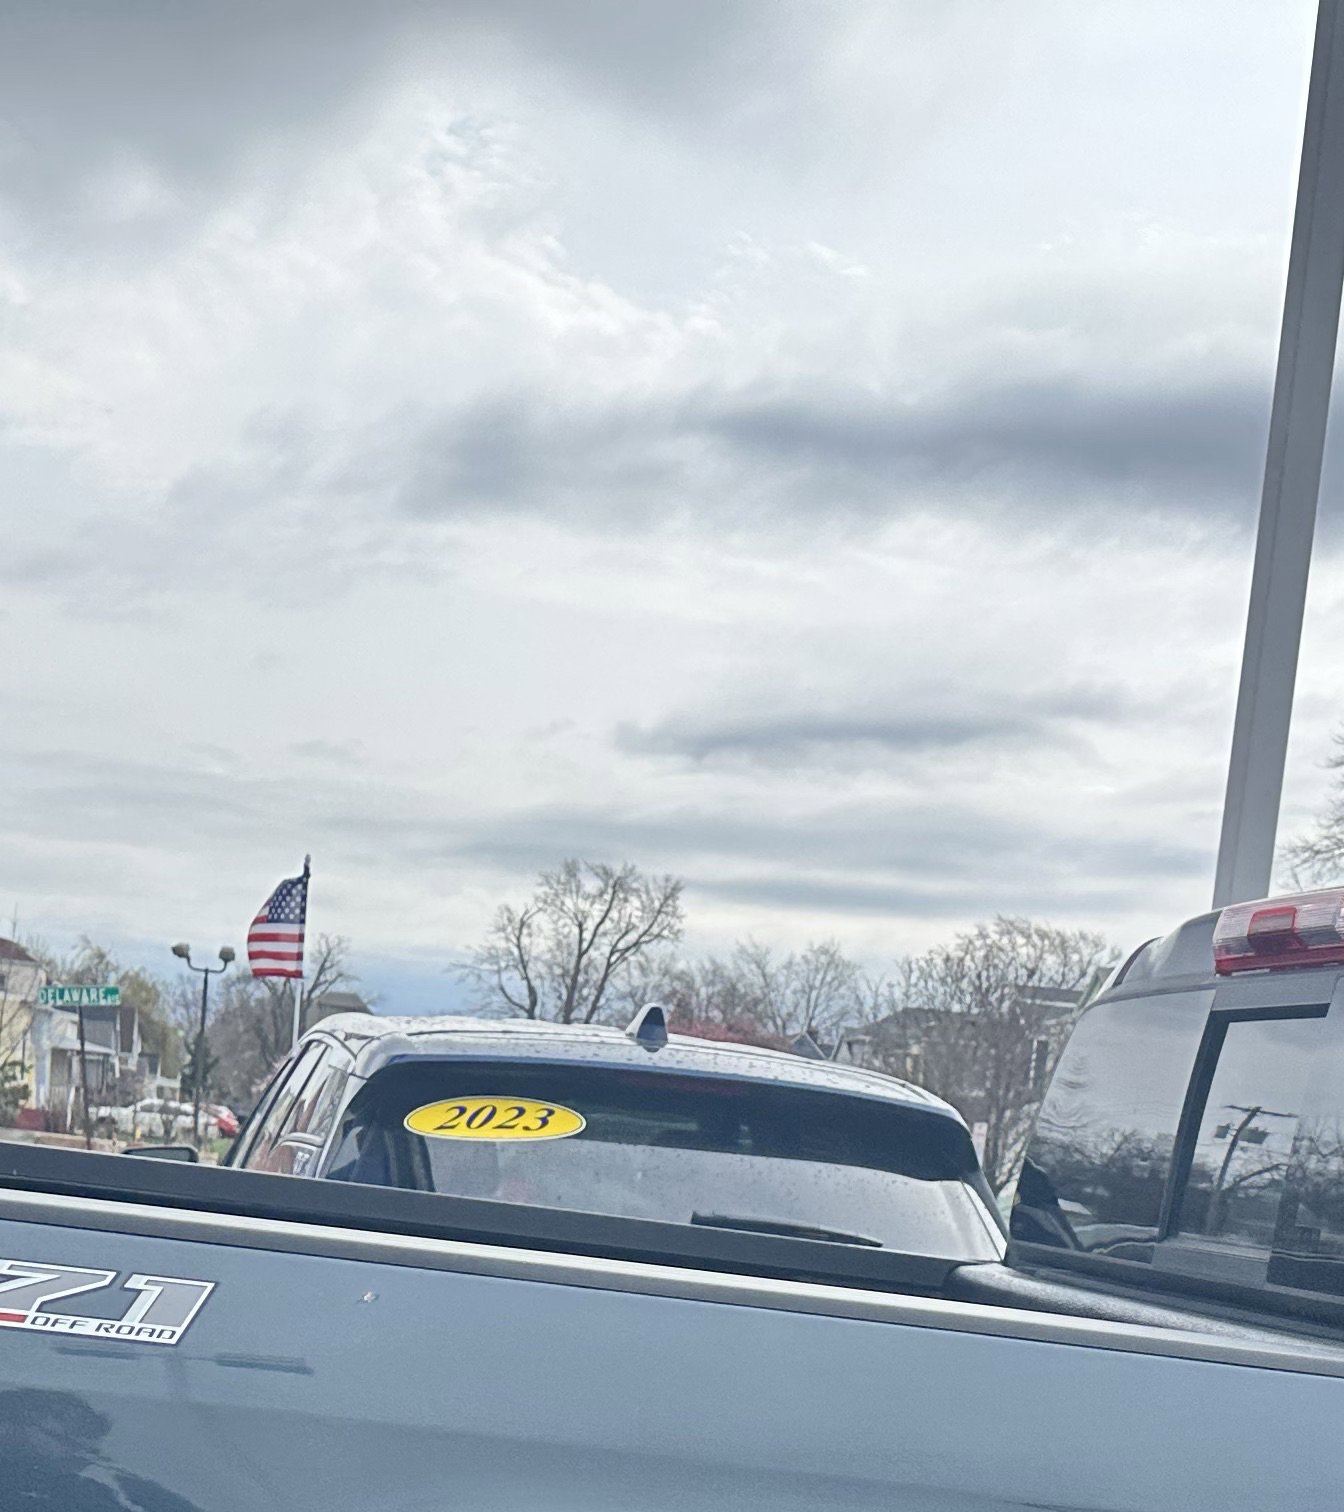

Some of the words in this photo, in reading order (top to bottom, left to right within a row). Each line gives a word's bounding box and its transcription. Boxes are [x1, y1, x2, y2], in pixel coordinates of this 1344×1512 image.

[38, 987, 106, 1005] DELAWARE
[433, 1104, 556, 1132] 2023
[30, 1315, 89, 1330] OFF
[95, 1322, 177, 1340] ROAD
